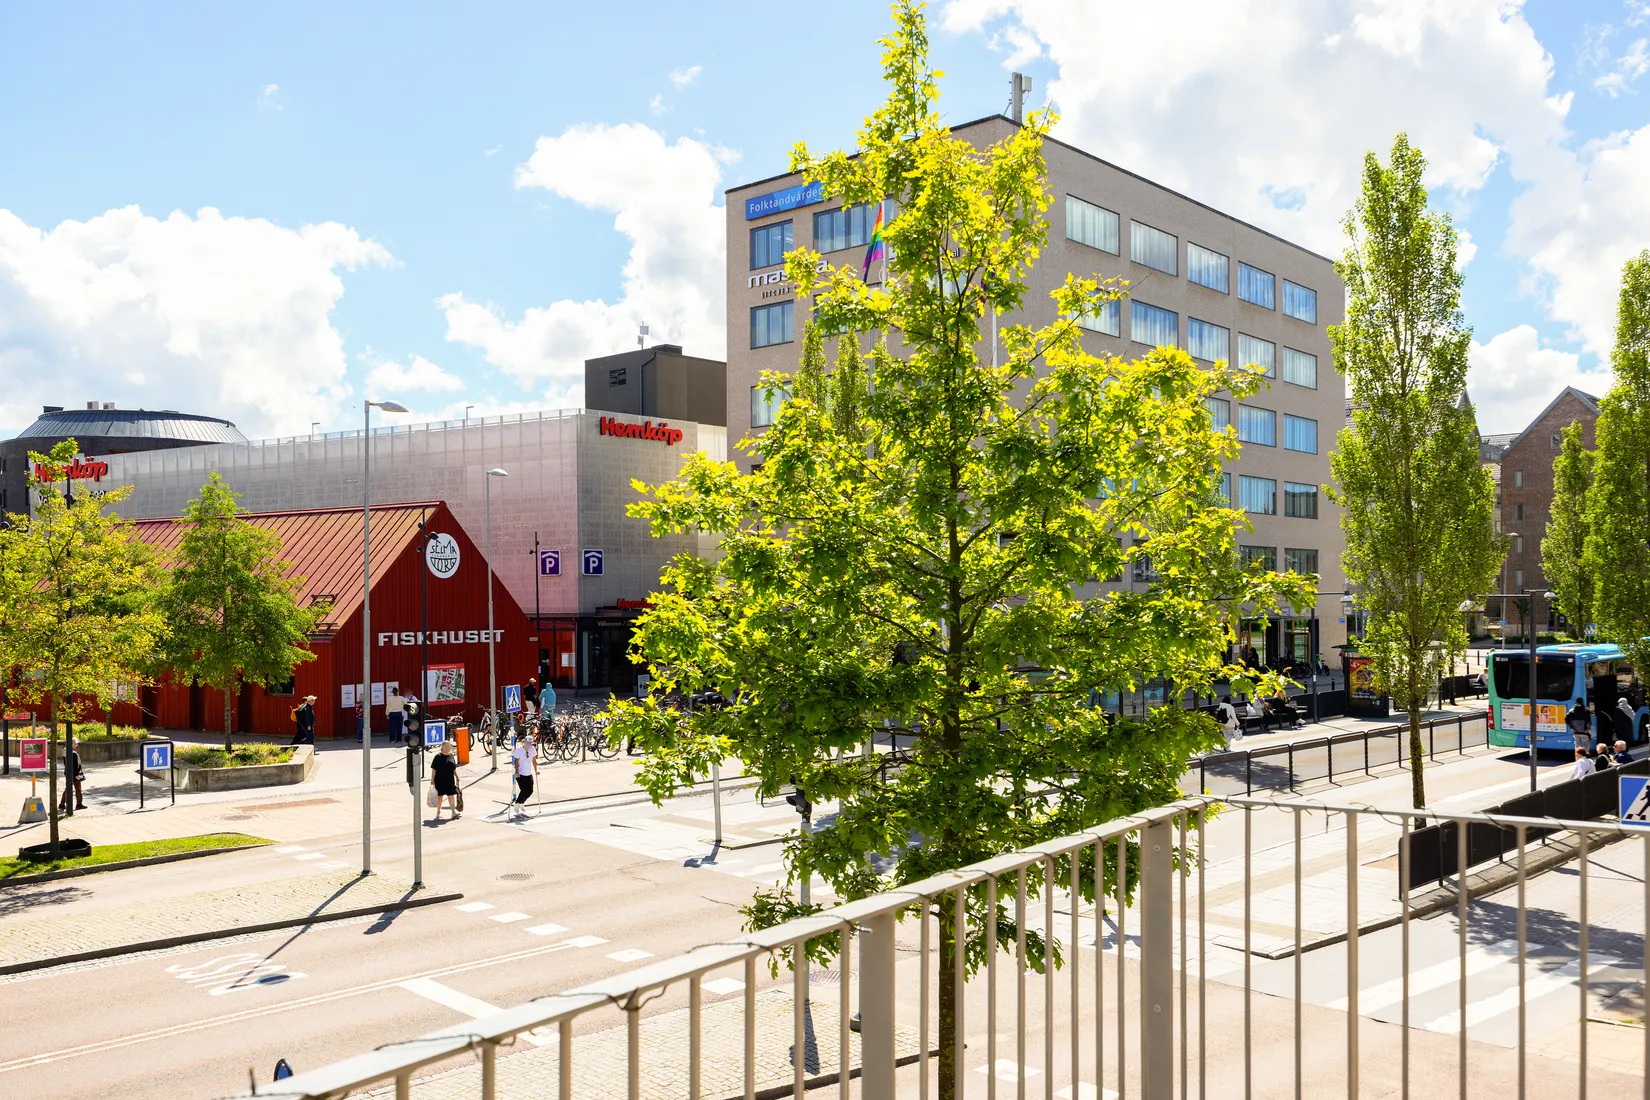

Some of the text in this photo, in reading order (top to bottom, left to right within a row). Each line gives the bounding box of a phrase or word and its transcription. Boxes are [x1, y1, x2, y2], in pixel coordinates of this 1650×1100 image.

[749, 186, 824, 213] Folktandvården
[748, 259, 829, 288] masa
[600, 415, 683, 446] Hemköp
[35, 456, 107, 483] Hköp
[502, 515, 520, 523] SELMA
[430, 540, 457, 554] SELMA
[431, 558, 456, 572] TORG
[546, 558, 555, 574] P
[589, 557, 599, 573] P
[617, 598, 658, 610] Hemk
[378, 630, 504, 647] FISKHUSET
